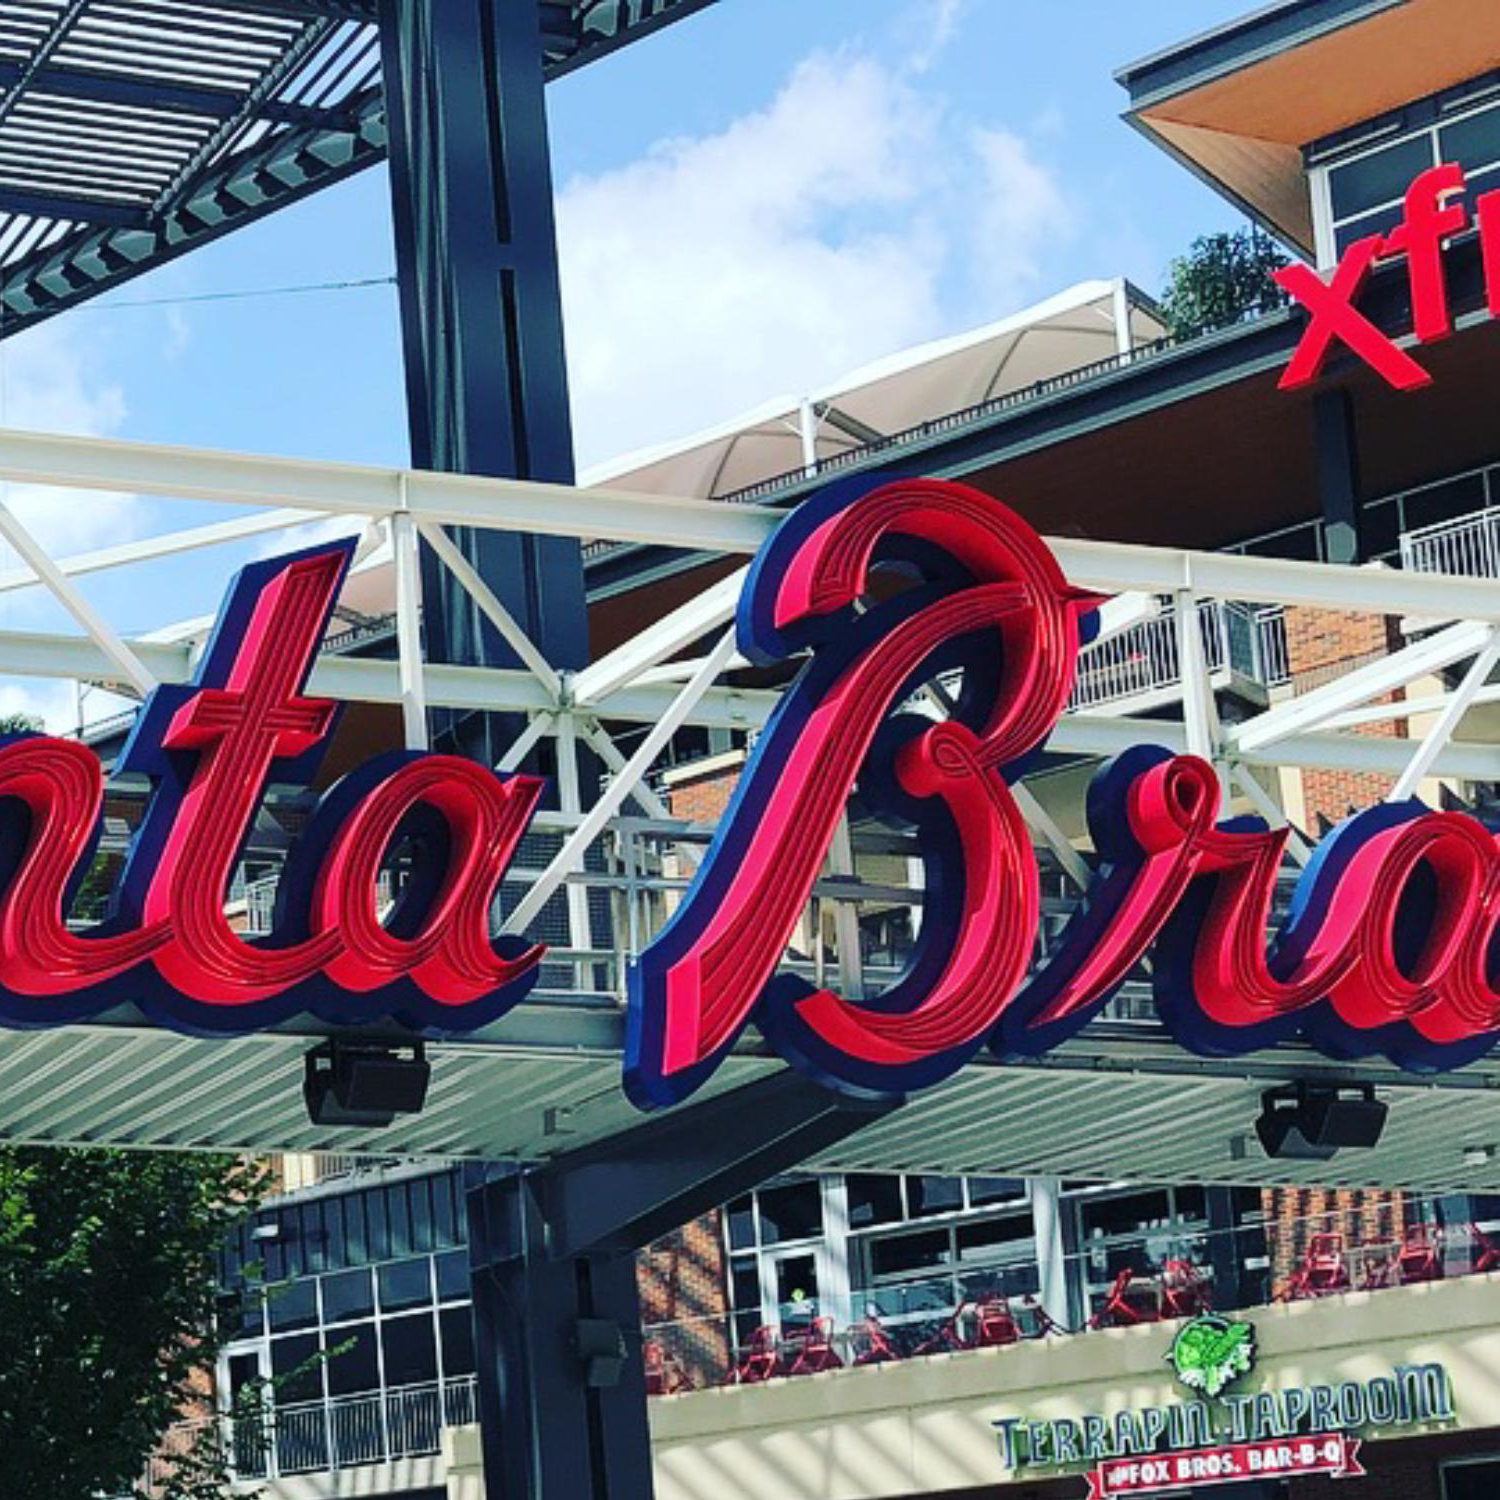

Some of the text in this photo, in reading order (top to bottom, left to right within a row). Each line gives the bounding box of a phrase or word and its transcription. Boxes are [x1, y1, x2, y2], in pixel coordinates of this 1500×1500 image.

[622, 472, 1500, 1112] Bra
[991, 1361, 1457, 1470] TERRAPIN TAPROOM
[1128, 1460, 1170, 1484] FOX
[1176, 1452, 1242, 1480] BROS.
[1247, 1440, 1340, 1471] BAR-B-Q
